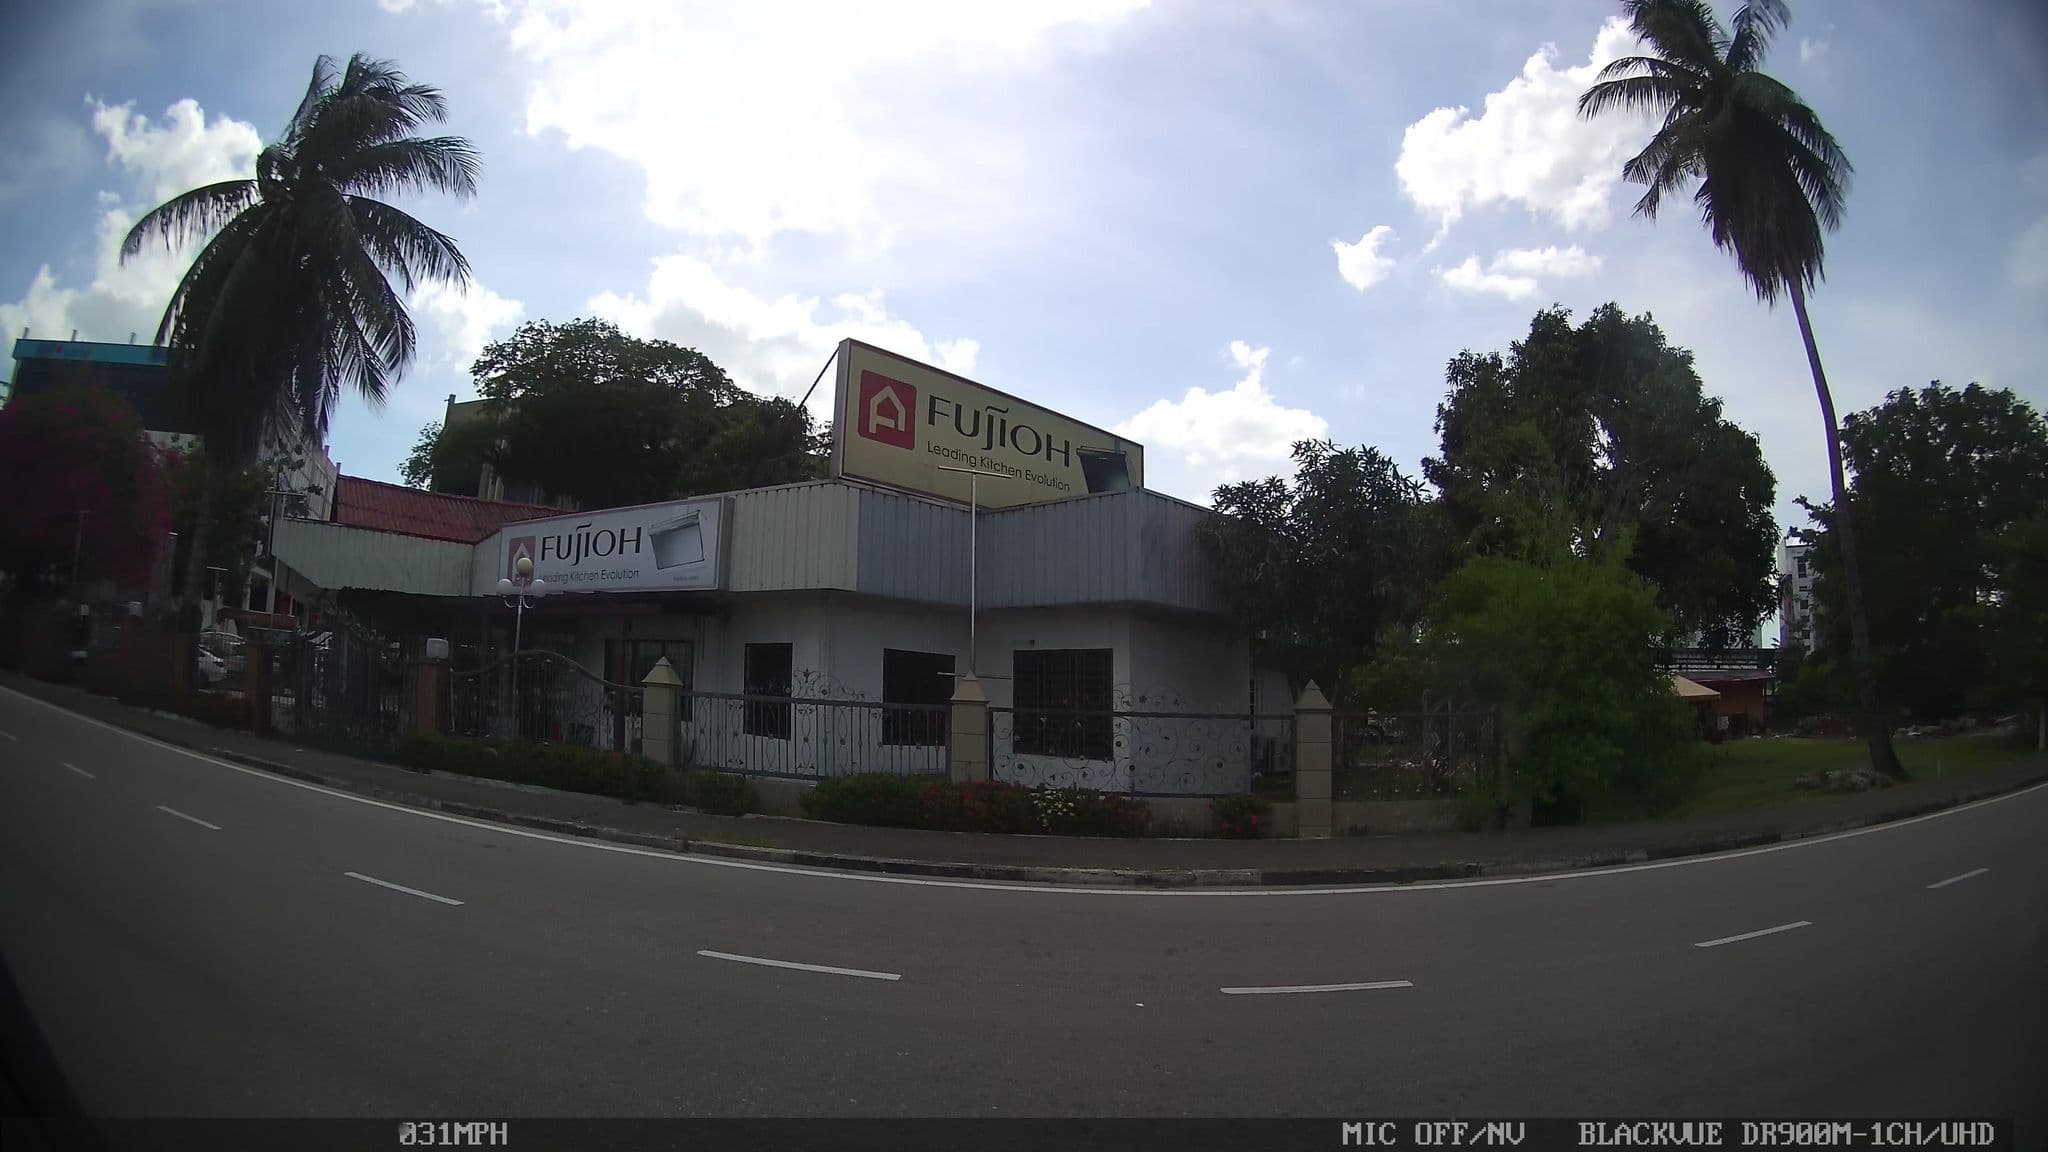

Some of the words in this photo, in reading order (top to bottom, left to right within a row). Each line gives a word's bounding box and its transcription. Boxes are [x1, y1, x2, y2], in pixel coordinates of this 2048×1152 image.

[927, 394, 1071, 468] FUJIOH
[927, 440, 978, 468] Leading
[978, 455, 1023, 480] Kitchen
[1024, 469, 1071, 493] Evolution
[540, 522, 643, 566] FUJIOH
[539, 573, 569, 584] eading
[570, 570, 599, 582] Kitchen
[600, 568, 640, 580] Evolution
